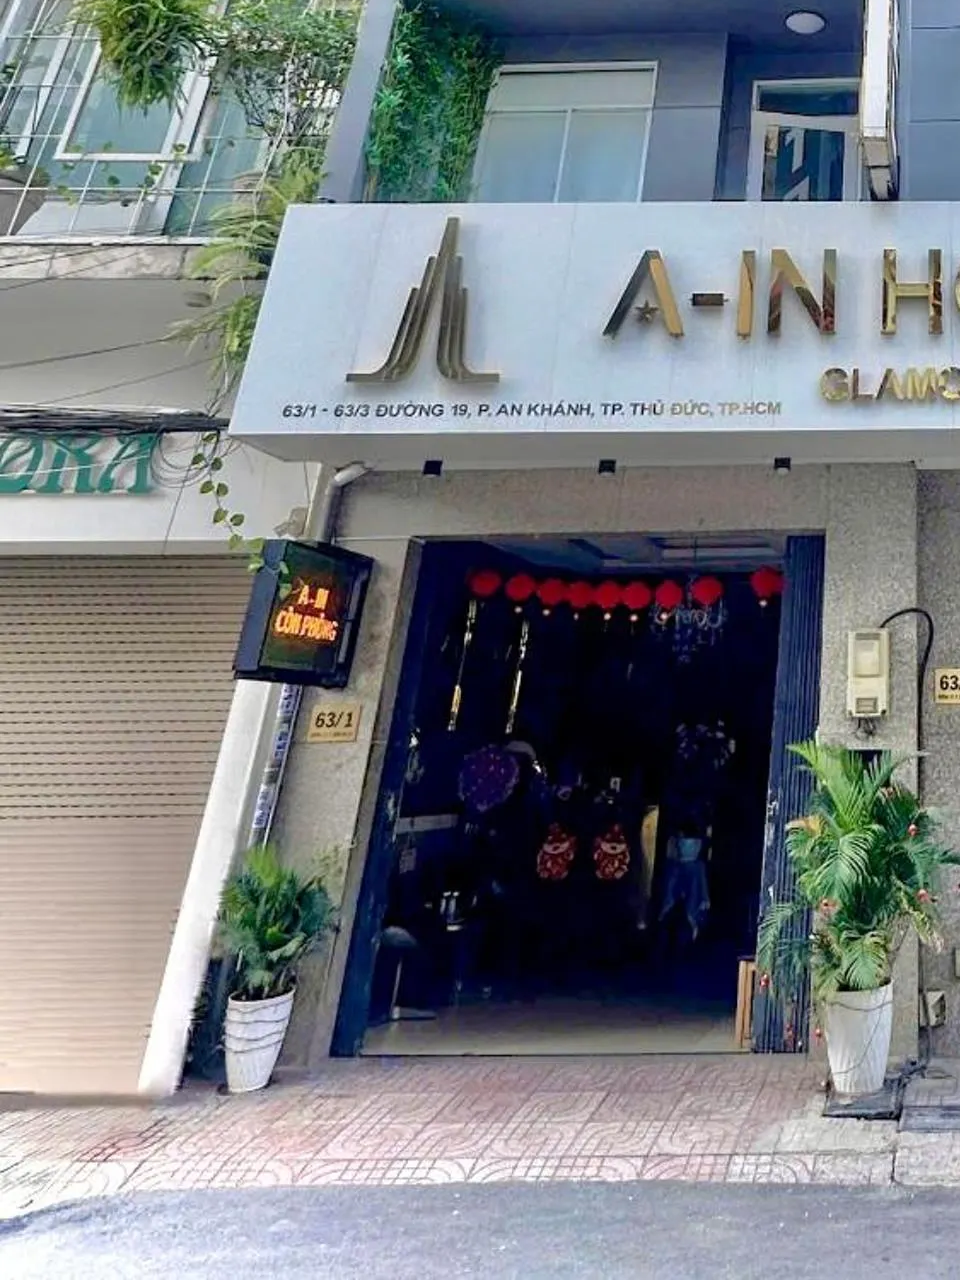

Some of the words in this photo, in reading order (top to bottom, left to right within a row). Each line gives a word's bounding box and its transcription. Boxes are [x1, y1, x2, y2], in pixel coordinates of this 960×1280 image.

[602, 249, 837, 338] A-IN
[282, 405, 317, 418] 63/1
[333, 405, 370, 418] 63/3
[375, 402, 445, 418] ĐƯỜNG
[452, 403, 472, 419] 19,
[477, 403, 493, 418] P.
[498, 403, 524, 417] AN
[527, 400, 595, 419] KHÁNH,
[602, 402, 625, 417] TP.
[718, 401, 782, 417] TP.HCM
[315, 711, 353, 728] 63/1
